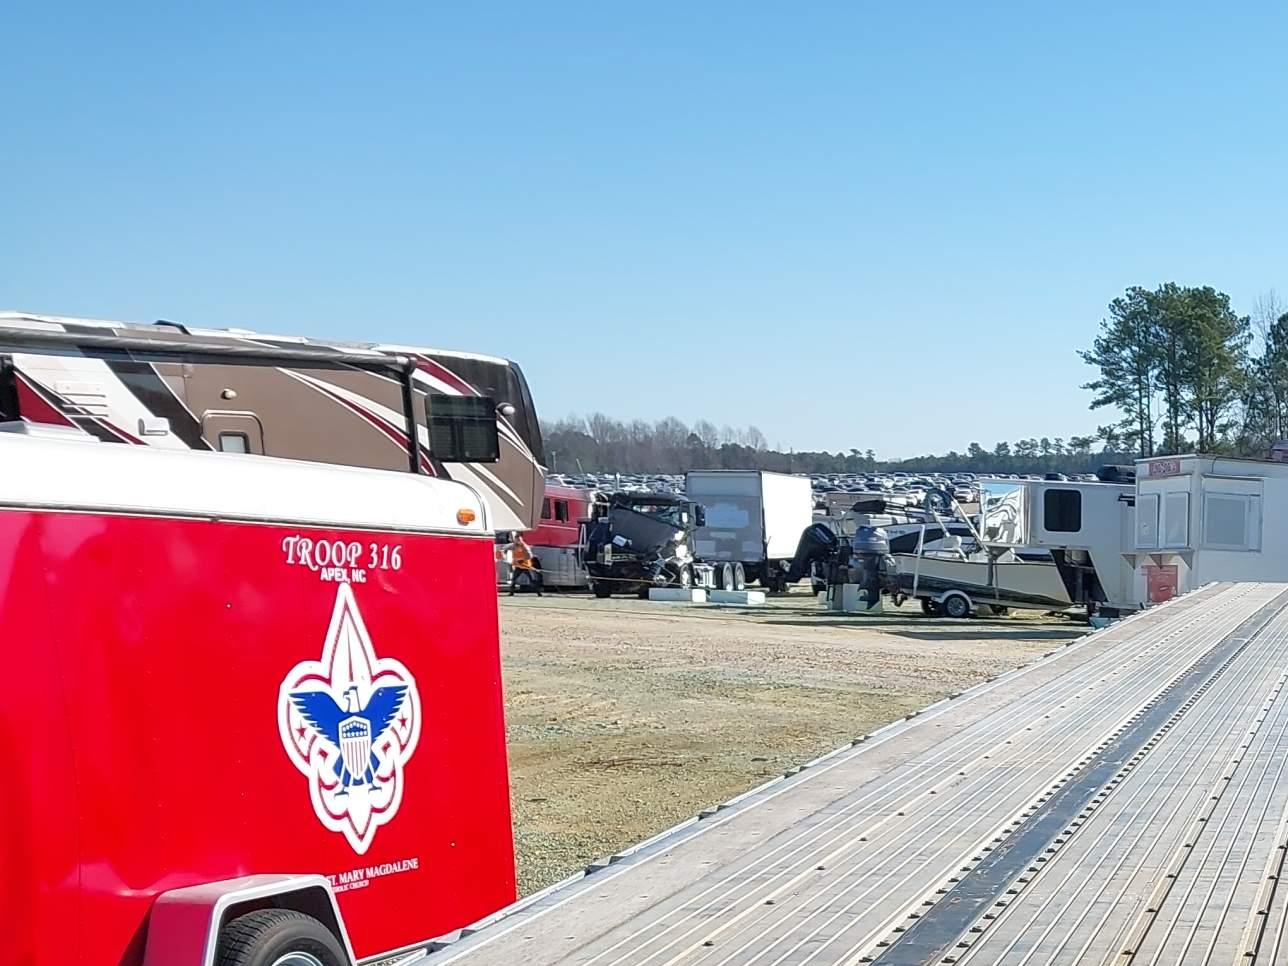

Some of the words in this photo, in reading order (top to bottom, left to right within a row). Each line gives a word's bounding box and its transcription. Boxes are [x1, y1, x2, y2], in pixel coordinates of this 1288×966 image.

[282, 534, 362, 571] TROOP
[367, 543, 402, 570] 316
[320, 567, 351, 584] APEX,
[351, 569, 366, 583] NC
[339, 869, 365, 884] MARY
[366, 858, 419, 878] MAGDALENE
